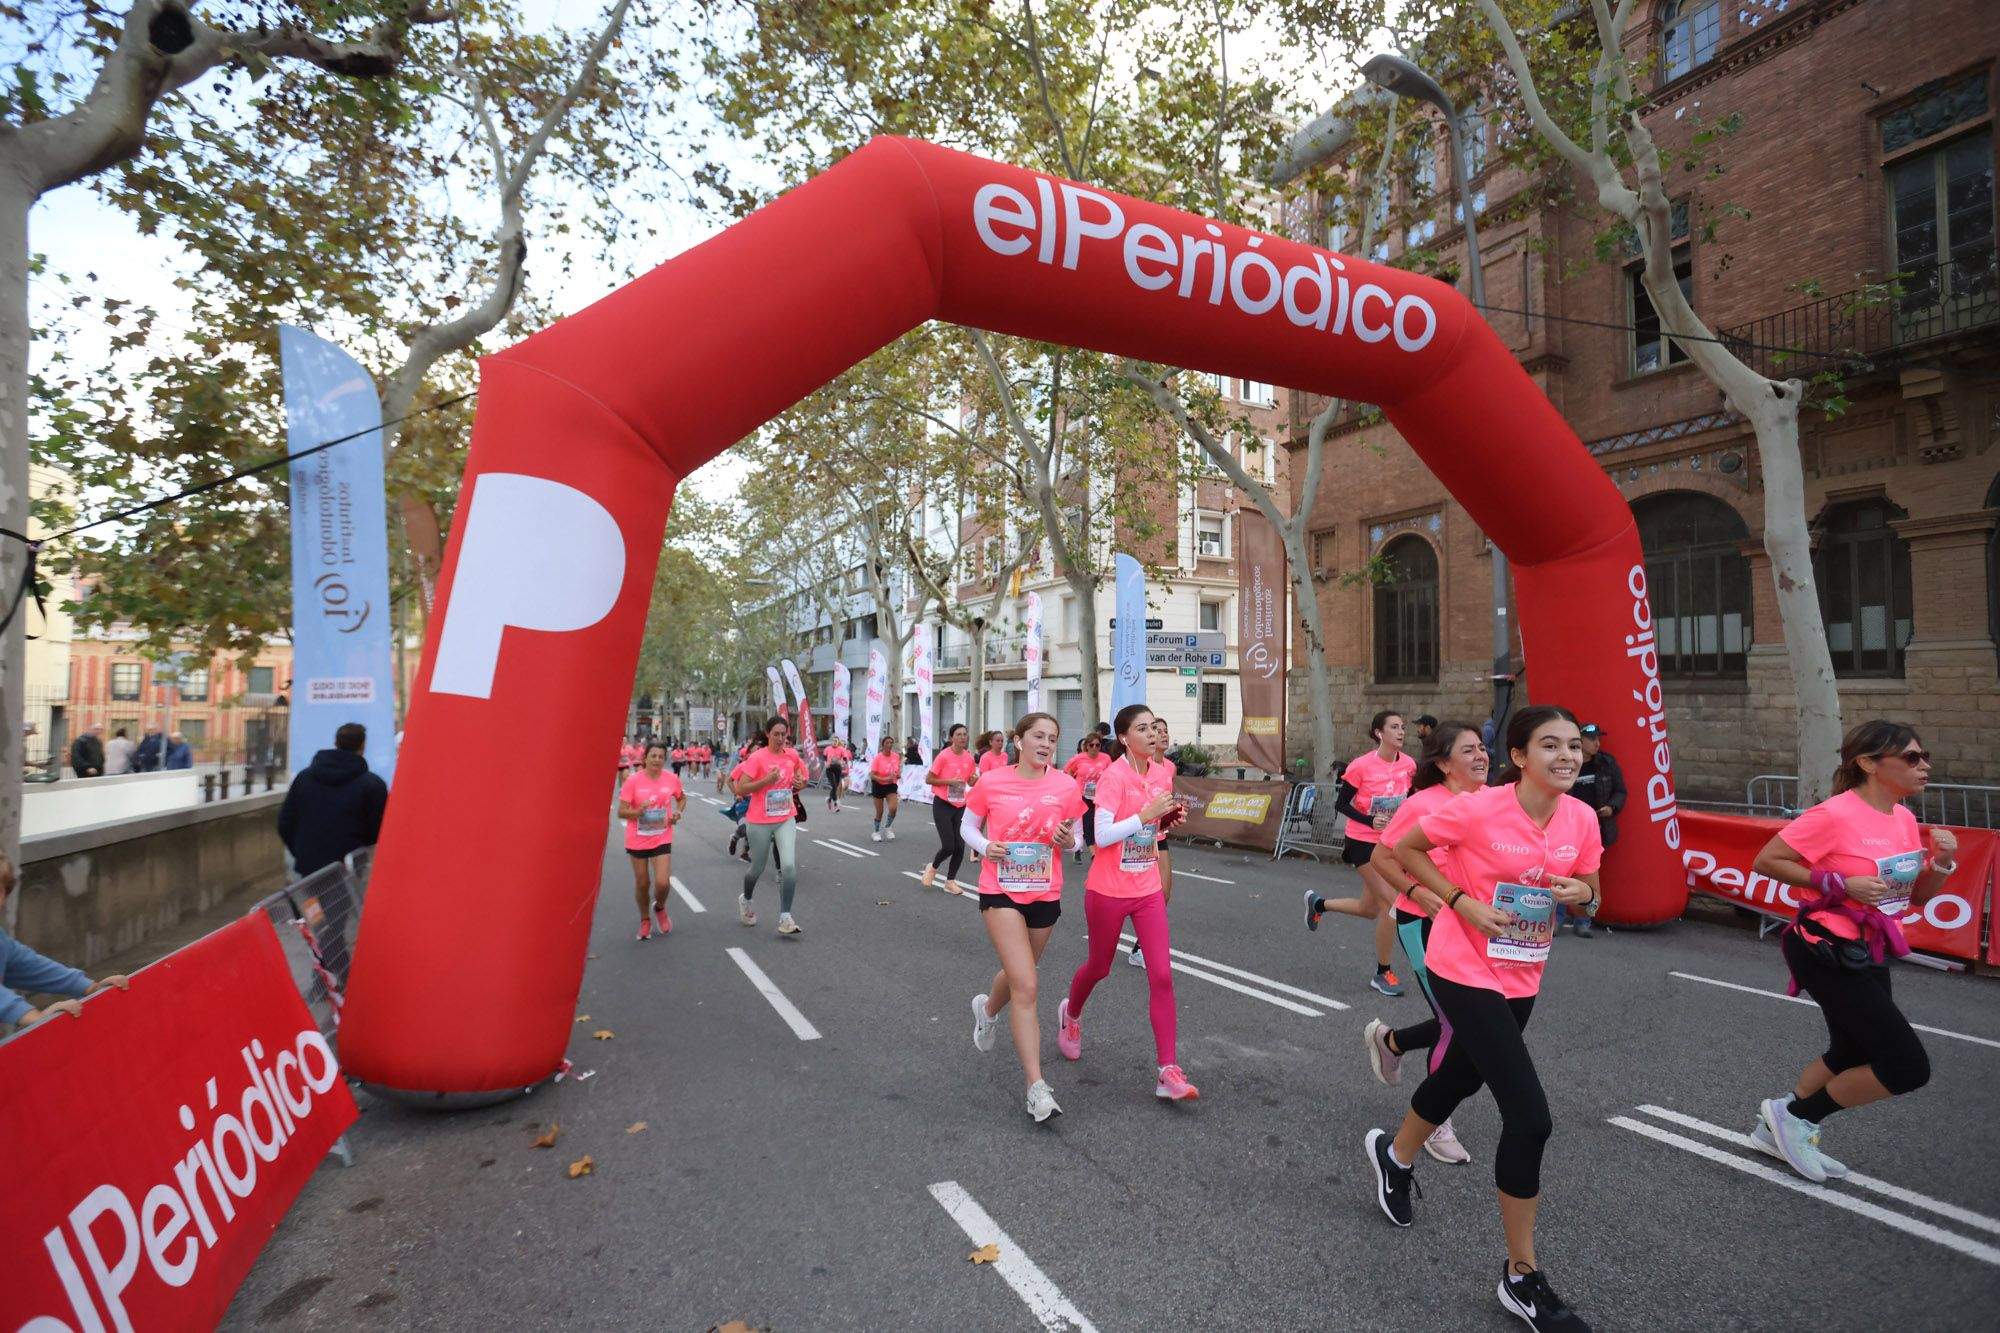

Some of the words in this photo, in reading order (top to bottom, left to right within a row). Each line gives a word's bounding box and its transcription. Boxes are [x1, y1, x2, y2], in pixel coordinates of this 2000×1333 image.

[972, 176, 1437, 353] elPeriódico
[430, 472, 626, 700] P
[1146, 620, 1162, 628] aulet
[1146, 634, 1183, 645] aForum
[1167, 653, 1182, 662] der
[1185, 653, 1207, 663] Rohe
[1626, 563, 1680, 850] elPeriódico
[1491, 842, 1529, 855] OYSHO
[1518, 919, 1547, 933] 016
